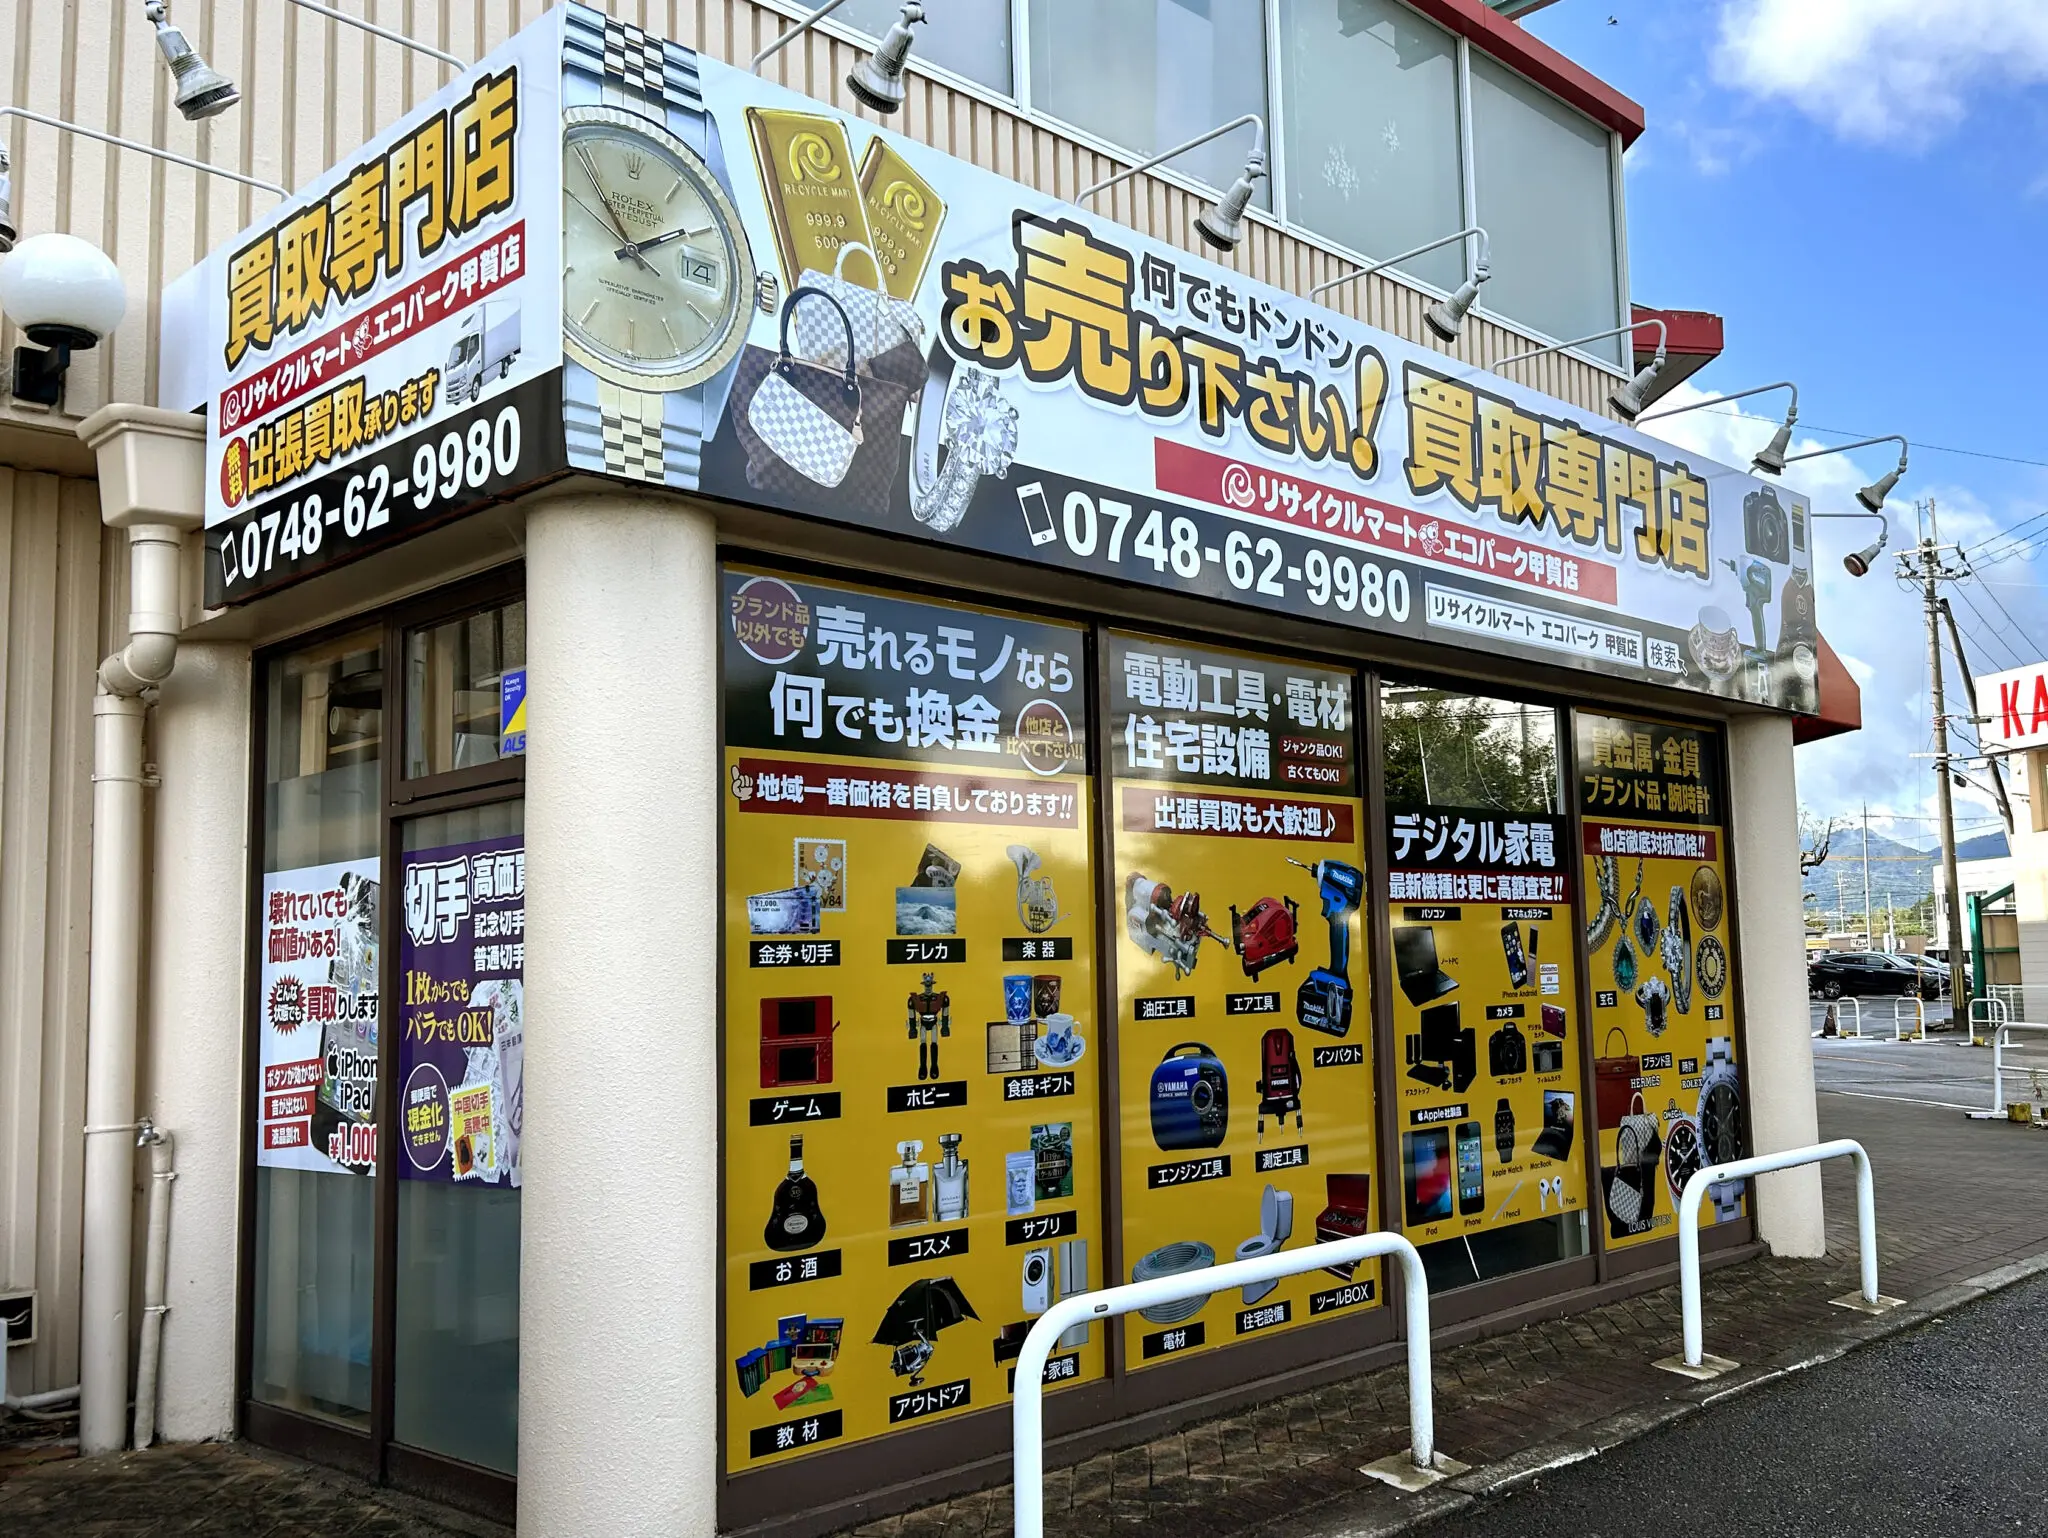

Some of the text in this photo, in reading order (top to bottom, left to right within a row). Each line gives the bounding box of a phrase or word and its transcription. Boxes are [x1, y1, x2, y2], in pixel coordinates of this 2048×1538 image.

[612, 192, 653, 212] ROLEX
[784, 183, 828, 197] RECYCLE
[225, 66, 518, 371] 買取専門店
[615, 210, 657, 228] ATEJUST
[806, 212, 846, 228] 999.9
[873, 226, 906, 259] 999.9
[685, 260, 711, 283] 14
[1141, 252, 1352, 368] 何でもドンドン
[241, 234, 520, 417] リサイクルマート エコパーク甲賀店
[941, 209, 1389, 480] お売り下さい!
[248, 369, 439, 496] 出張買取承ります
[227, 442, 243, 503] 無料
[1403, 361, 1710, 579] 買取専門店
[241, 406, 520, 578] 0748-62-9980
[1258, 476, 1578, 592] リサイクルマート エコパーク甲賀店
[1062, 491, 1409, 622] 0748-62-9980
[731, 595, 810, 626] ブランド品
[736, 622, 804, 649] 以外でも
[1434, 596, 1637, 659] リサイクルマート エコパーク 甲賀店
[815, 605, 1073, 693] 売れるモノなら
[1650, 642, 1677, 669] 検索
[1124, 651, 1347, 732] 電動工具・電材
[769, 671, 1001, 753] 何でも換金
[2000, 674, 2048, 739] KA
[1025, 716, 1063, 736] 他店と
[1125, 713, 1270, 780] 住宅設備
[1283, 740, 1342, 758] ジャンク品OK!
[1592, 726, 1700, 779] 貴金属・金貨
[1288, 765, 1339, 782] 古くてもOK!
[1585, 774, 1710, 815] ブランド品・腕時計
[1393, 813, 1555, 867] デジタル家電
[269, 888, 348, 925] 壊れていても
[407, 861, 468, 941] 切手
[474, 909, 524, 938] 記念切手
[1421, 909, 1445, 919] パソコン
[269, 928, 341, 963] 価値がある!
[474, 943, 524, 971] 普通切手
[758, 943, 833, 965] 金券・切手
[906, 943, 948, 960] テレカ
[1022, 941, 1055, 958] 楽器
[276, 985, 297, 1001] どんな
[406, 970, 469, 1006] 1枚からでも
[307, 986, 378, 1022] 買取りします
[1143, 1000, 1187, 1017] 油圧工具
[1233, 996, 1273, 1011] エア工具
[1496, 1007, 1514, 1017] カメラ
[406, 1012, 493, 1046] バラでもOK!
[1316, 1048, 1361, 1064] インパクト
[1643, 1054, 1671, 1068] ブランド品
[267, 1064, 322, 1087] ボタンが効かない
[1007, 1078, 1072, 1098] 食器・ギフト
[1164, 1081, 1188, 1092] YAMAHA
[272, 1096, 308, 1117] 音が出ない
[341, 1082, 371, 1110] iPad
[454, 1091, 489, 1115] 中国切手
[907, 1089, 950, 1106] ホビー
[408, 1102, 443, 1132] 現金化
[772, 1102, 821, 1119] ゲーム
[412, 1131, 441, 1146] できません
[1263, 1149, 1302, 1168] 測定工具
[1158, 1160, 1223, 1183] エンジン工具
[1022, 1217, 1060, 1239] サプリ
[909, 1236, 950, 1259] コスメ
[776, 1257, 817, 1281] お酒
[1317, 1284, 1369, 1306] ツールBOX
[1243, 1306, 1284, 1330] 住宅設備
[1163, 1331, 1186, 1350] 電材
[1043, 1357, 1074, 1379] ・家電
[896, 1385, 964, 1416] アウトドア
[777, 1421, 819, 1448] 教材
